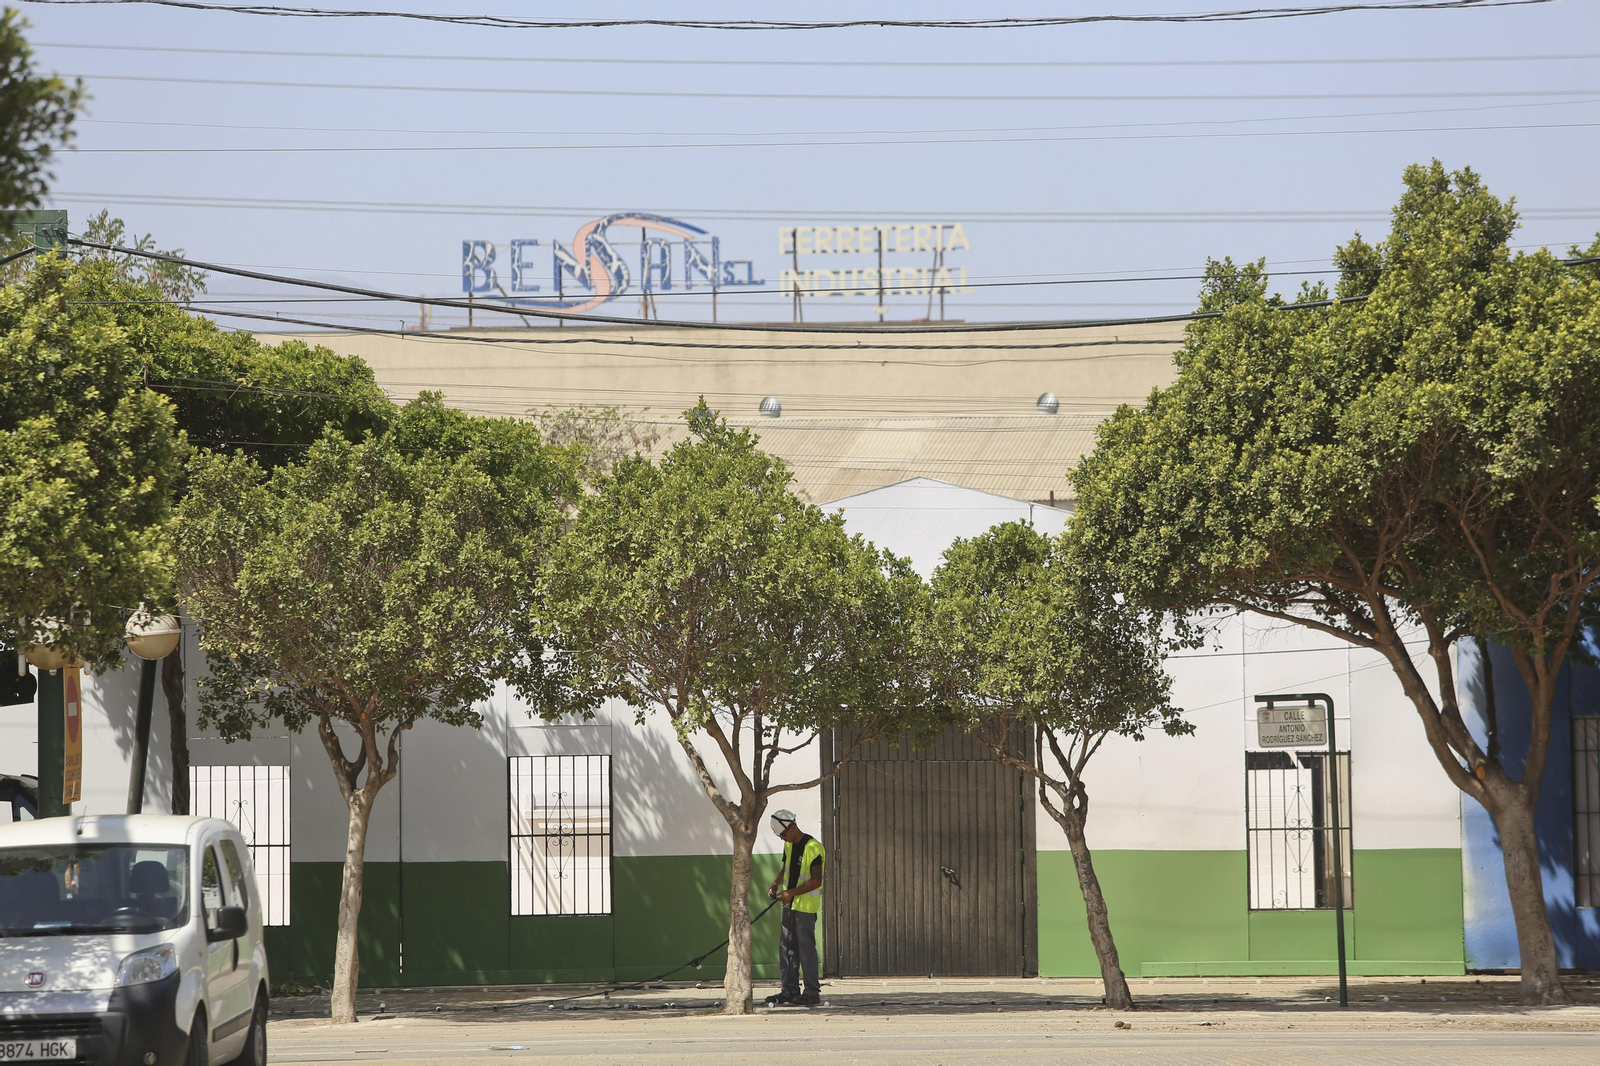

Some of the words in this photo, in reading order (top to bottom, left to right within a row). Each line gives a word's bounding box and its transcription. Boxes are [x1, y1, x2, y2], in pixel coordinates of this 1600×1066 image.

[778, 223, 971, 255] FERRETERIA
[461, 212, 719, 310] BENSAN
[779, 266, 974, 297] INDUSTRIAL
[1284, 711, 1305, 720] CALLE
[1279, 724, 1305, 732] ANTONIO
[1262, 734, 1294, 743] RODRÍGUEZ
[1296, 733, 1323, 742] SÁNCHEZ
[40, 1042, 68, 1057] HGK
